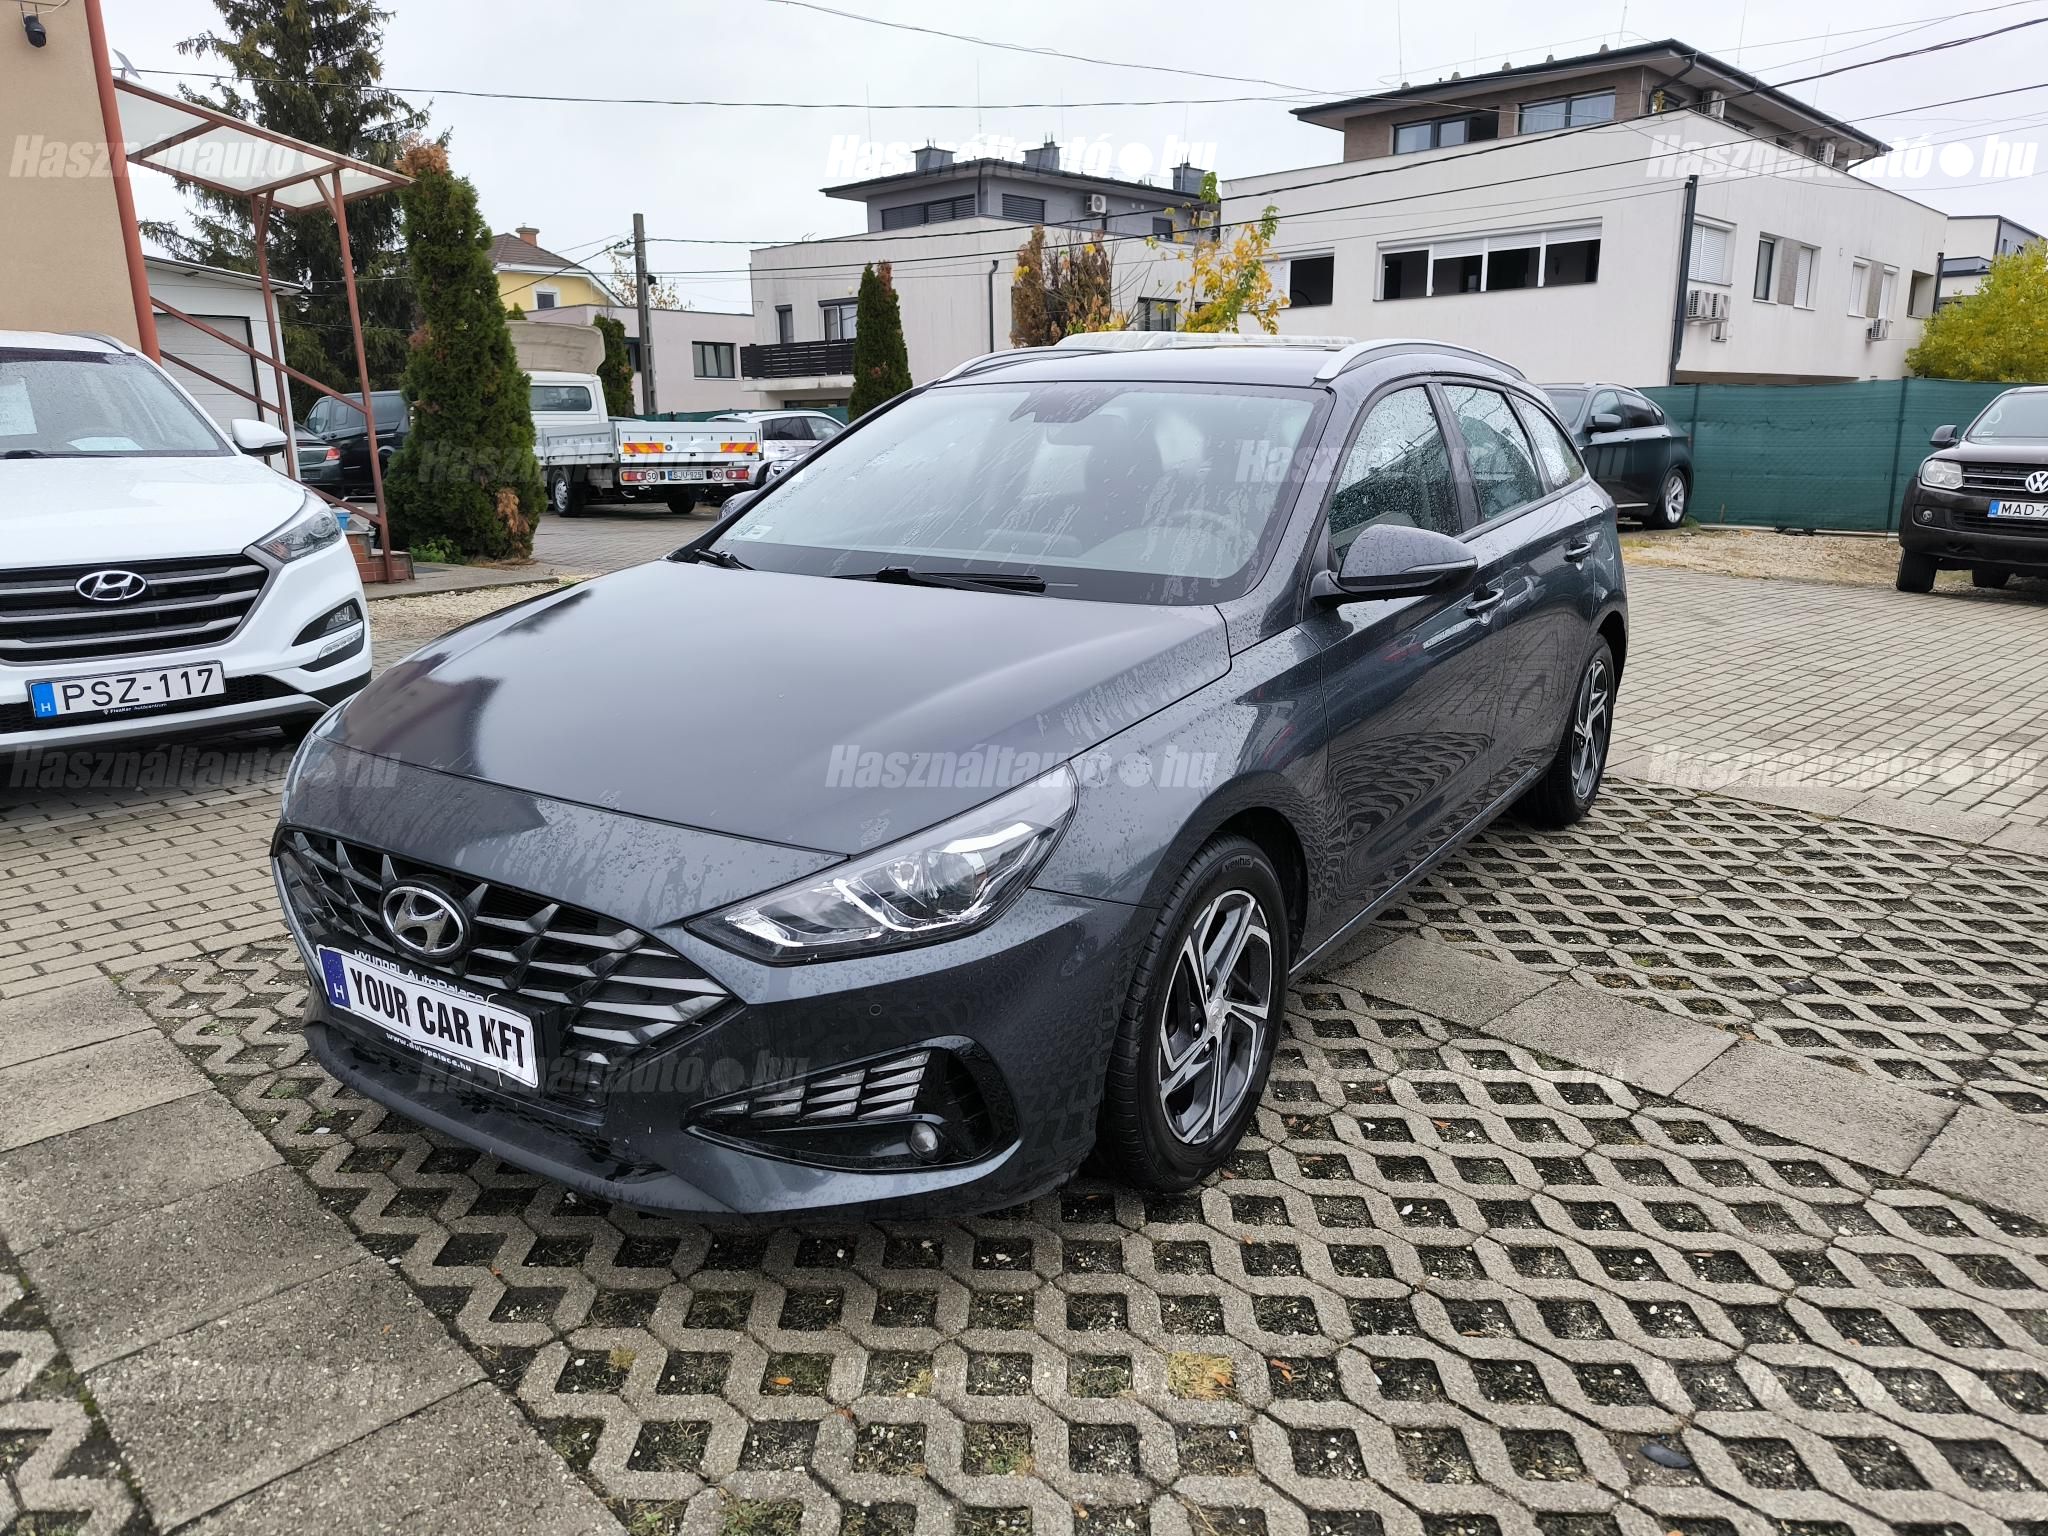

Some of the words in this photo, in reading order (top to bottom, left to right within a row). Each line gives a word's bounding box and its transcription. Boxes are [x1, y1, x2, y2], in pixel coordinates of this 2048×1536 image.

[61, 668, 214, 711] PSZ-117
[350, 967, 412, 1028] YOUR
[416, 995, 474, 1049] CAR
[478, 1013, 525, 1069] KFT
[385, 1031, 472, 1073] www.autopalace.hu
